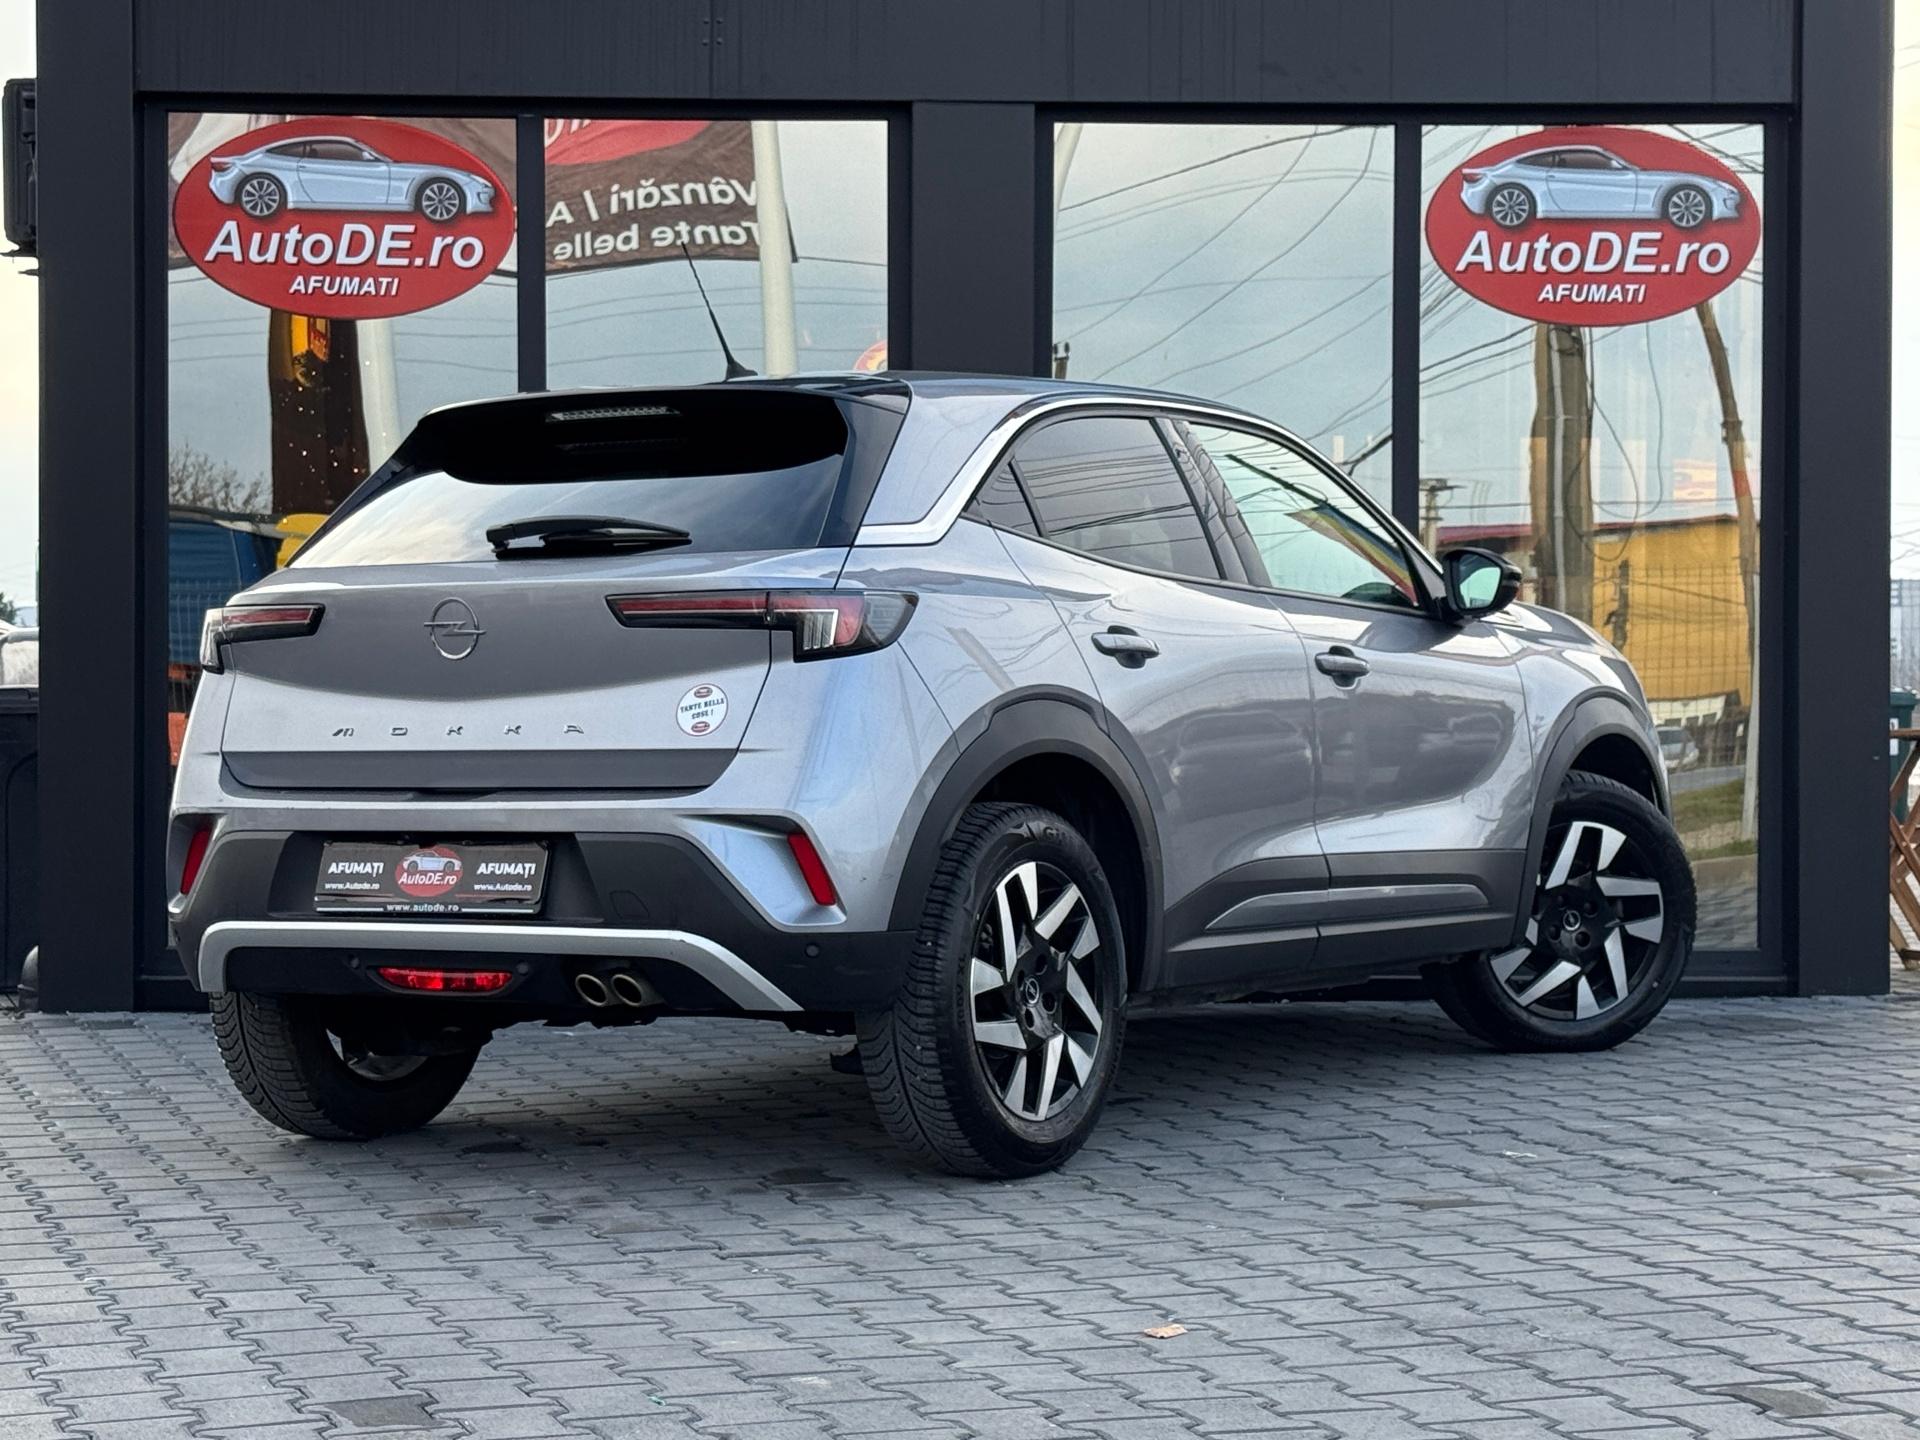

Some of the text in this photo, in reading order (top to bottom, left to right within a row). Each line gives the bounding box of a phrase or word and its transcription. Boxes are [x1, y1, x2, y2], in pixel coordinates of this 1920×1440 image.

[204, 220, 486, 268] AutoDE.ro
[1454, 230, 1731, 275] AutoDE.ro
[289, 275, 400, 297] AFUMATI
[1537, 284, 1647, 304] AFUMATI
[398, 872, 458, 886] AutoDE.ro
[386, 903, 460, 913] www.autode.ro
